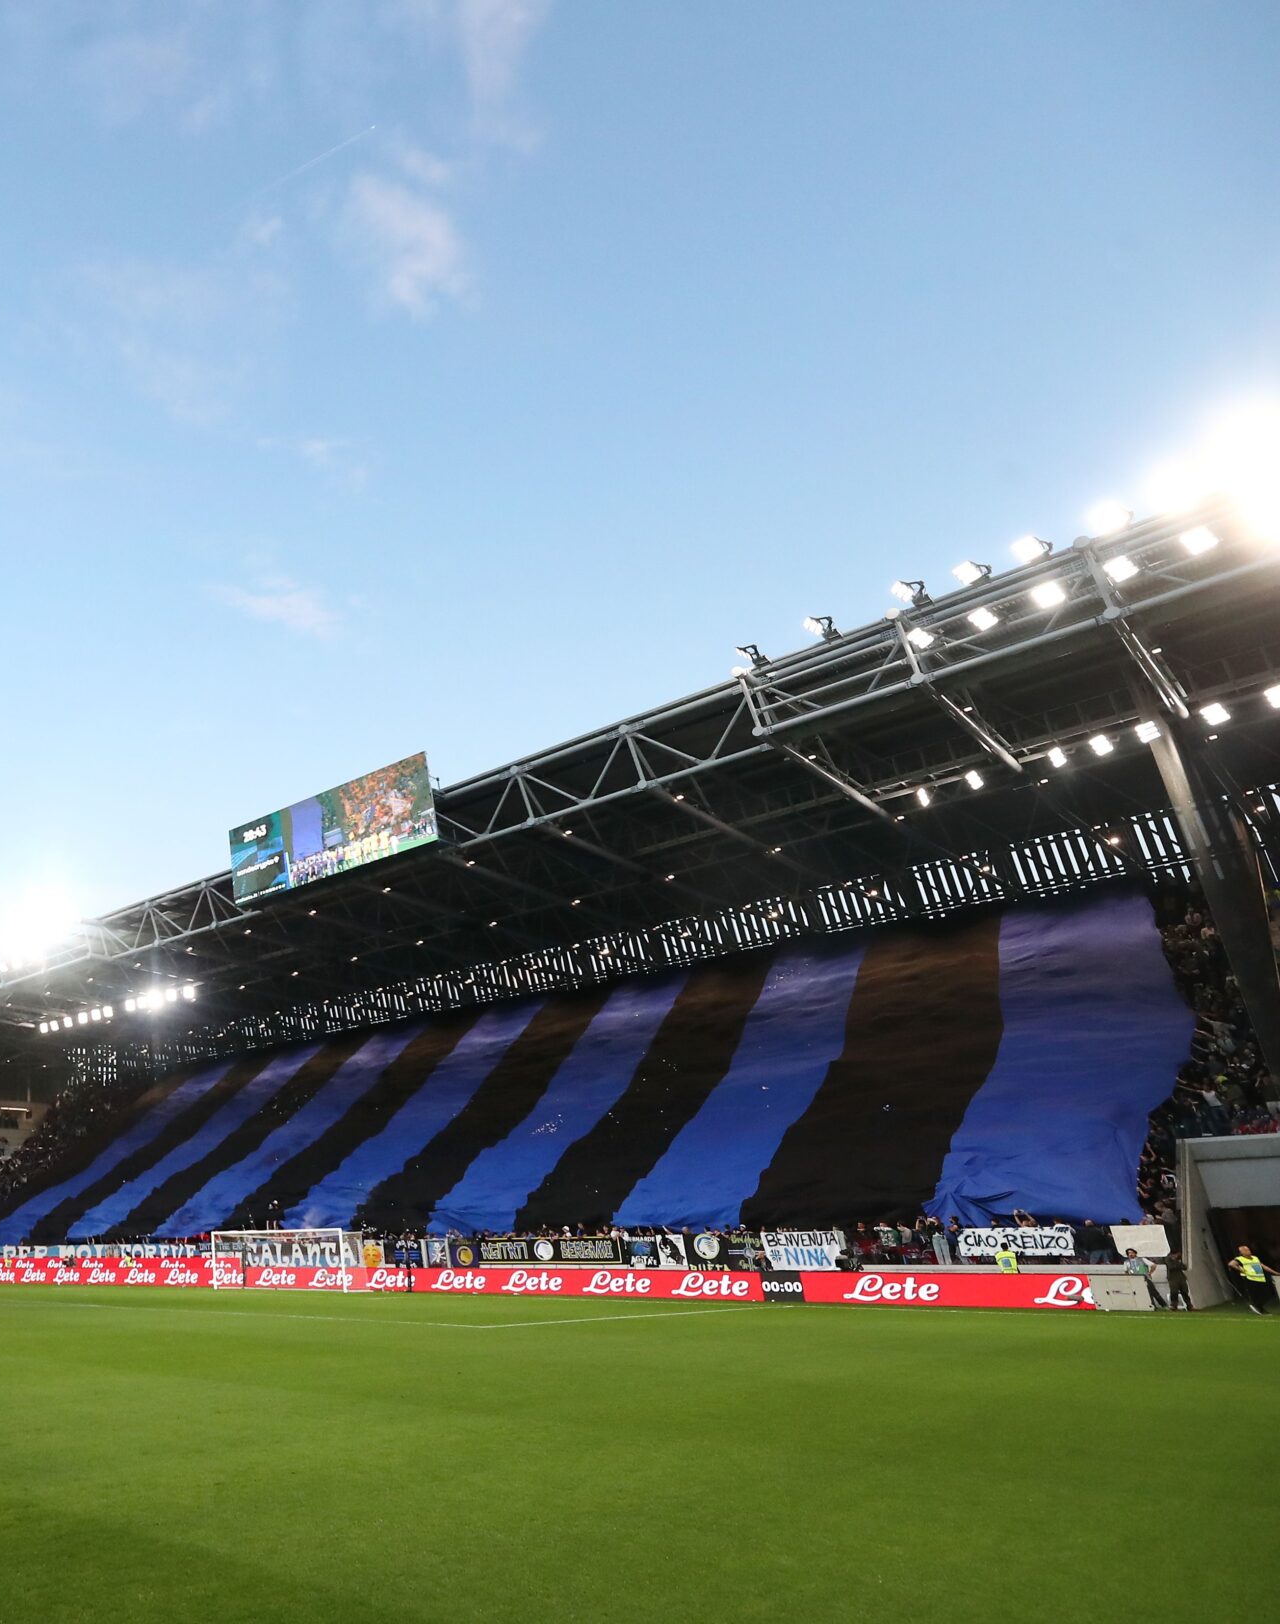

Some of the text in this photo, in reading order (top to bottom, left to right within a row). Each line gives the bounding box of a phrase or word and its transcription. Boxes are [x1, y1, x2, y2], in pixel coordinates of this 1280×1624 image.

[765, 1231, 838, 1248] BENVENUTA
[964, 1231, 1069, 1249] CIAO RENZO
[784, 1247, 832, 1267] NINA
[20, 1268, 47, 1282] Lete
[53, 1268, 80, 1283] Lete
[86, 1268, 116, 1283] Lete
[124, 1268, 156, 1284] Lete
[164, 1268, 199, 1285] Lete
[208, 1268, 244, 1285] Lete
[255, 1268, 296, 1286] Lete
[308, 1269, 353, 1287] Lete
[366, 1269, 416, 1289] Lete
[431, 1269, 486, 1290] Lete
[501, 1270, 563, 1292] Lete
[582, 1271, 651, 1293] Lete
[671, 1272, 749, 1297] Lete
[761, 1280, 803, 1293] 00:00
[843, 1274, 940, 1301] Lete
